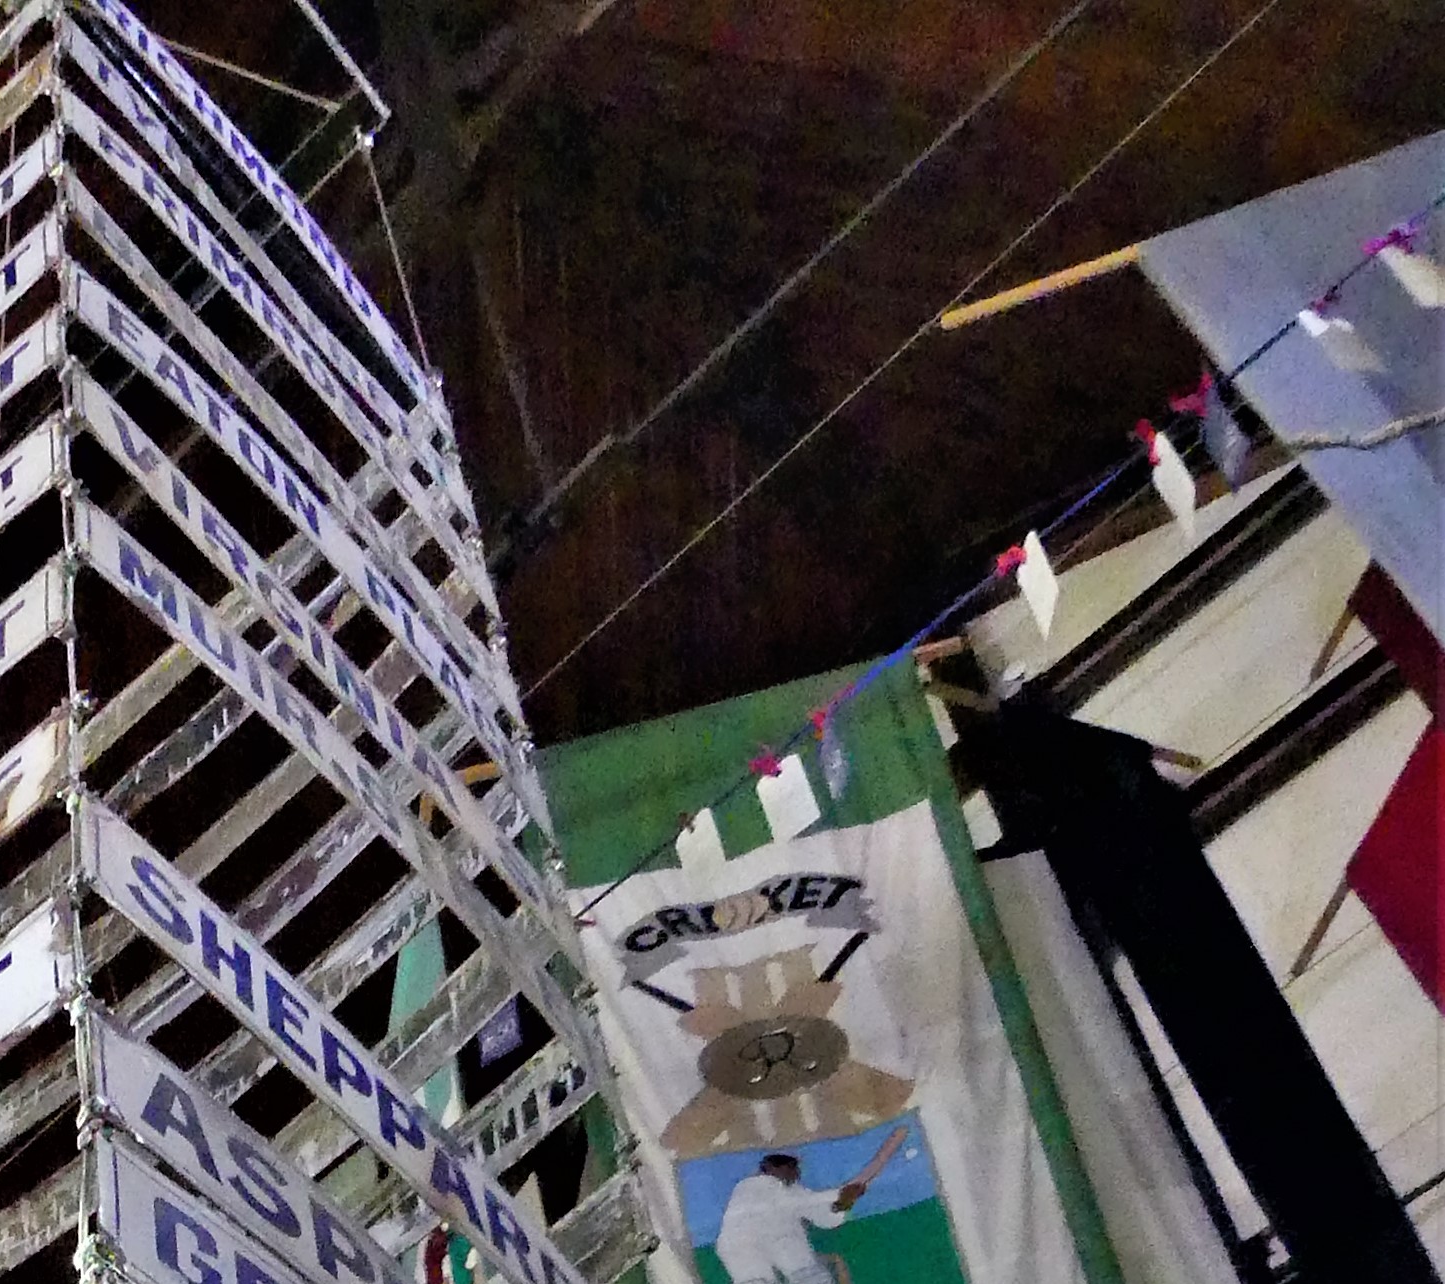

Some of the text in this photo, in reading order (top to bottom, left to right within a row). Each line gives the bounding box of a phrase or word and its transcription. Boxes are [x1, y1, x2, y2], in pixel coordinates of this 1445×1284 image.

[108, 301, 321, 538] EATON
[110, 406, 461, 818] VIRGINIA
[118, 535, 324, 758] MUIR
[625, 877, 862, 952] CRIKET
